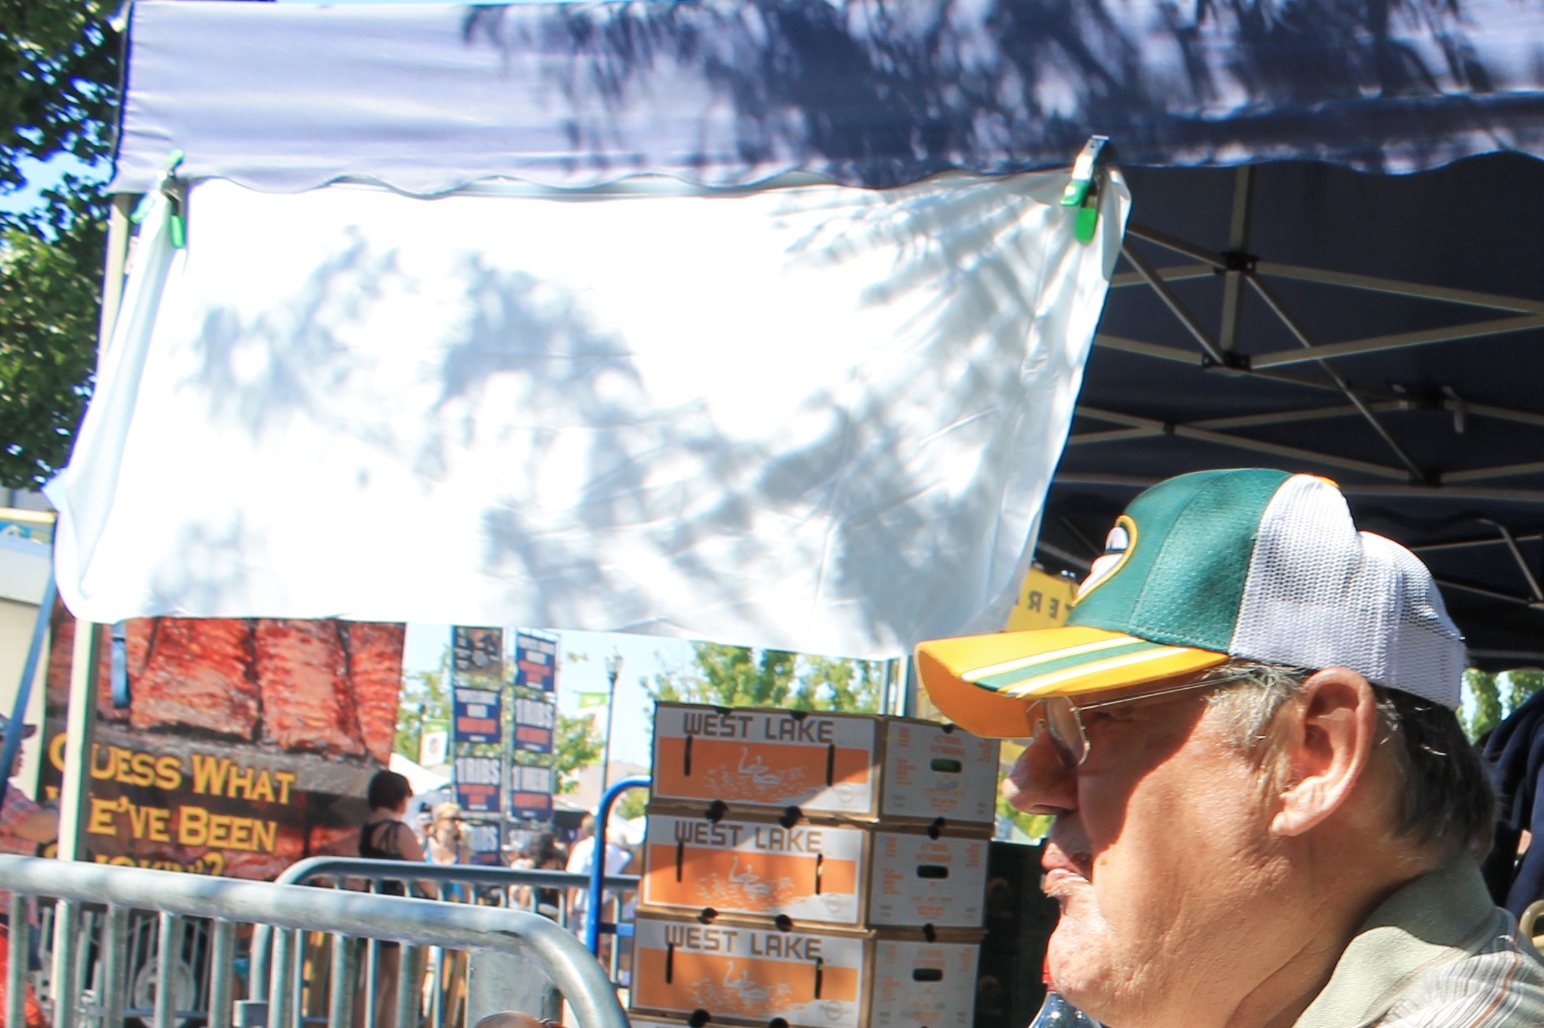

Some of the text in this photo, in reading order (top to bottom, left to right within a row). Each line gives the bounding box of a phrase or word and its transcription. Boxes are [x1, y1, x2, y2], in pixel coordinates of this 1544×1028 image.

[684, 713, 834, 742] WEST LAKE
[191, 753, 296, 804] WHAT
[45, 786, 277, 851] E'VE BEEN
[675, 821, 822, 853] WEST LAKE
[665, 925, 822, 960] WEST LAKE
